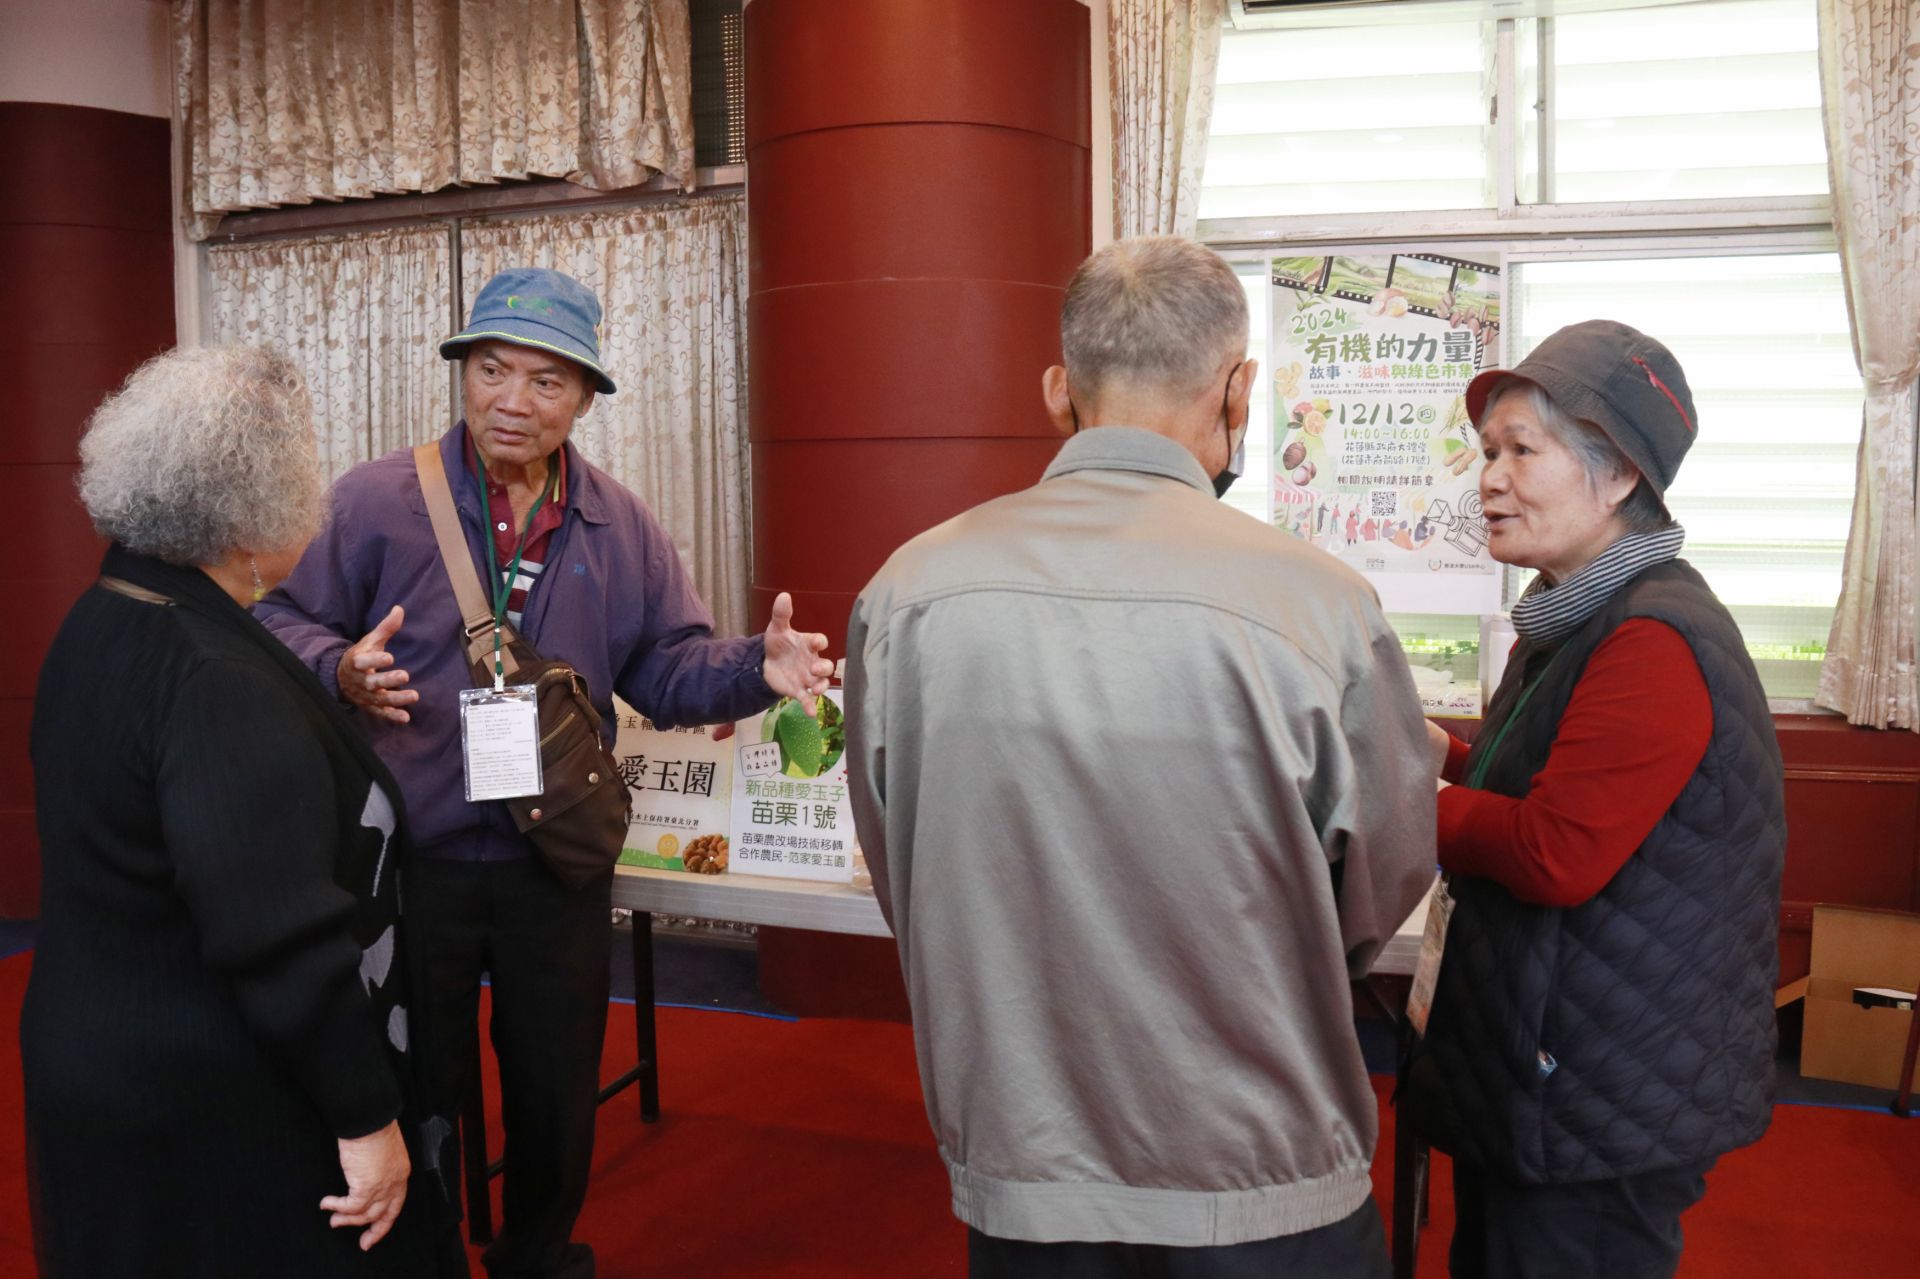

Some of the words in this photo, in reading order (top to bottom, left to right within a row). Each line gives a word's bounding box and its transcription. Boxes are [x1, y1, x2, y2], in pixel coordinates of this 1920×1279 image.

[1291, 307, 1347, 334] 2024
[1304, 331, 1473, 363] 有機的力量
[1339, 403, 1414, 425] 12/12
[1337, 475, 1433, 487] 相關說明請詳簡章
[617, 754, 717, 798] 愛玉園
[745, 779, 845, 802] 新品種愛玉子
[751, 800, 837, 830] 苗栗1號
[742, 832, 844, 851] 苗栗農改場技術移轉
[738, 847, 846, 868] 合作農民-范家愛玉園
